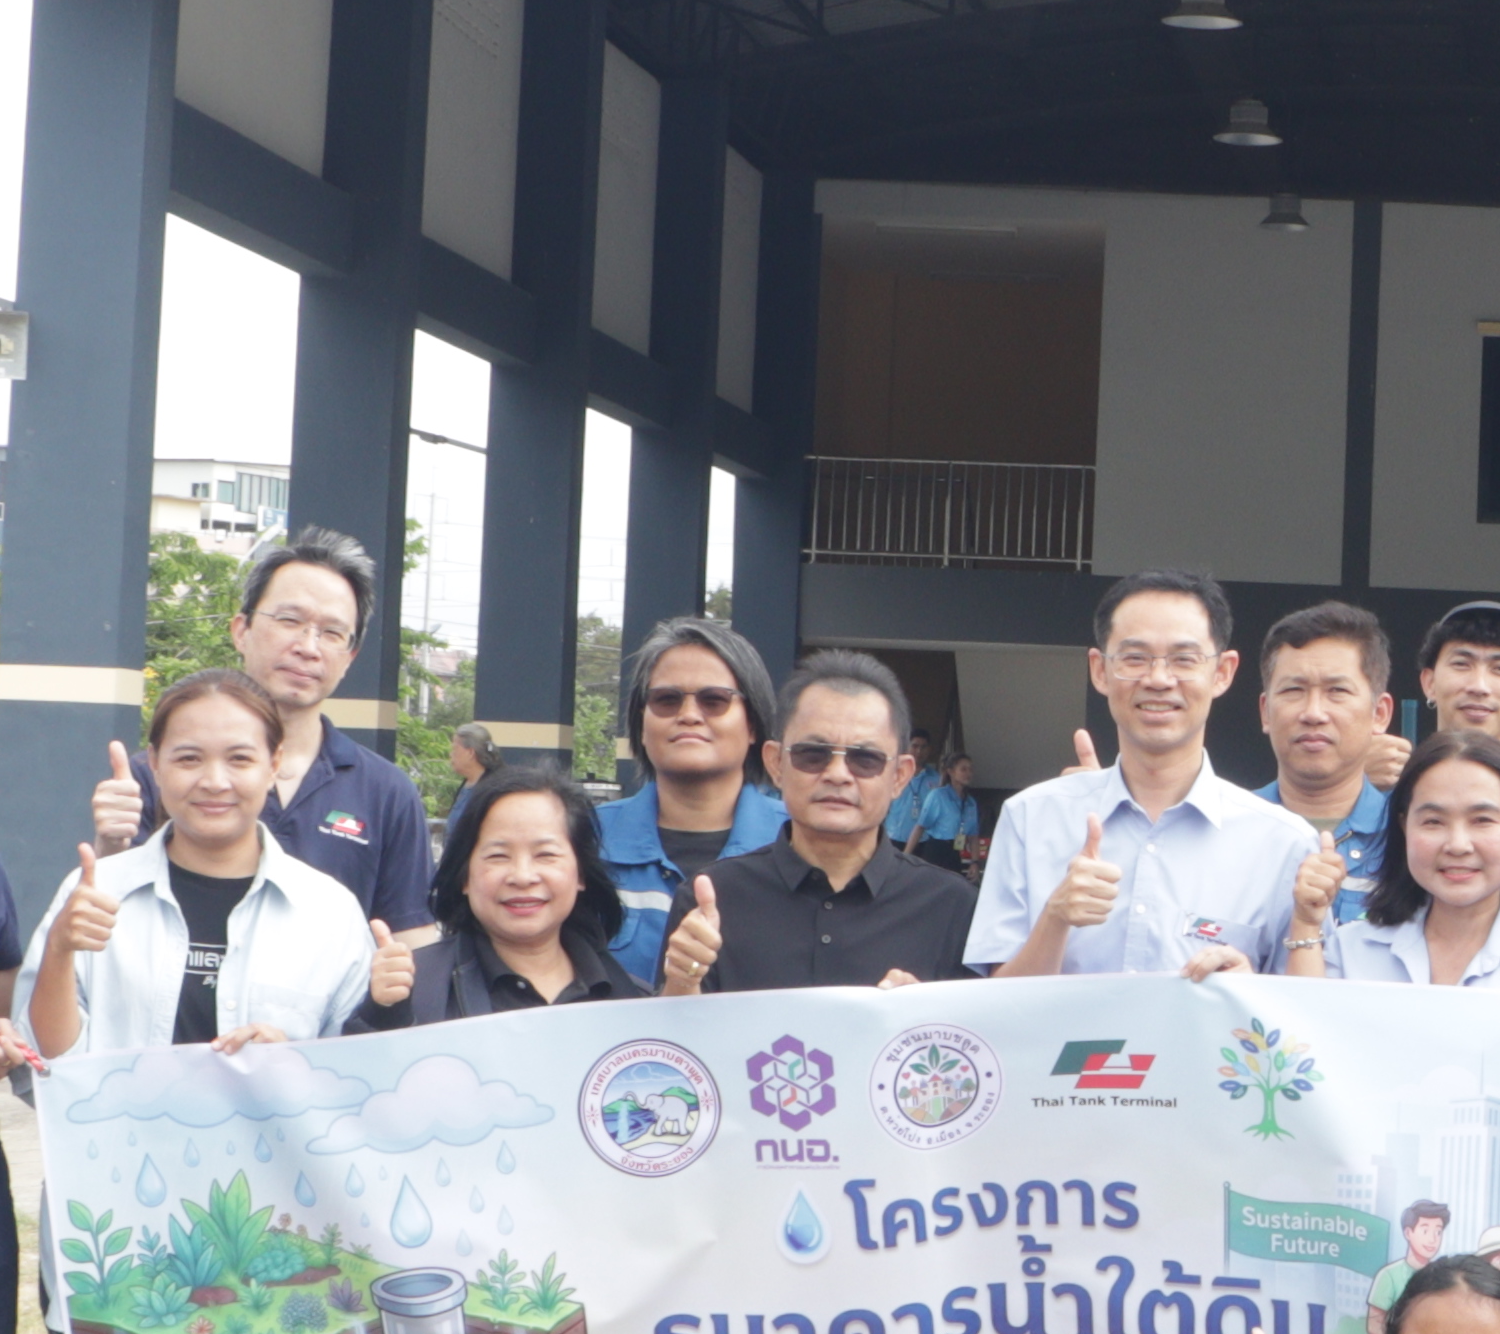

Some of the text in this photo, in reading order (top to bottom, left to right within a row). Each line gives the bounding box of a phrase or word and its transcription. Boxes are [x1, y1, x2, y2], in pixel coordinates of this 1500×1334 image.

[1031, 1095, 1178, 1108] Thai Tank Terminal
[755, 1139, 840, 1162] กนอ.
[843, 1178, 1140, 1251] โครงการ
[1241, 1205, 1368, 1242] Sustainable
[1270, 1233, 1340, 1257] Future
